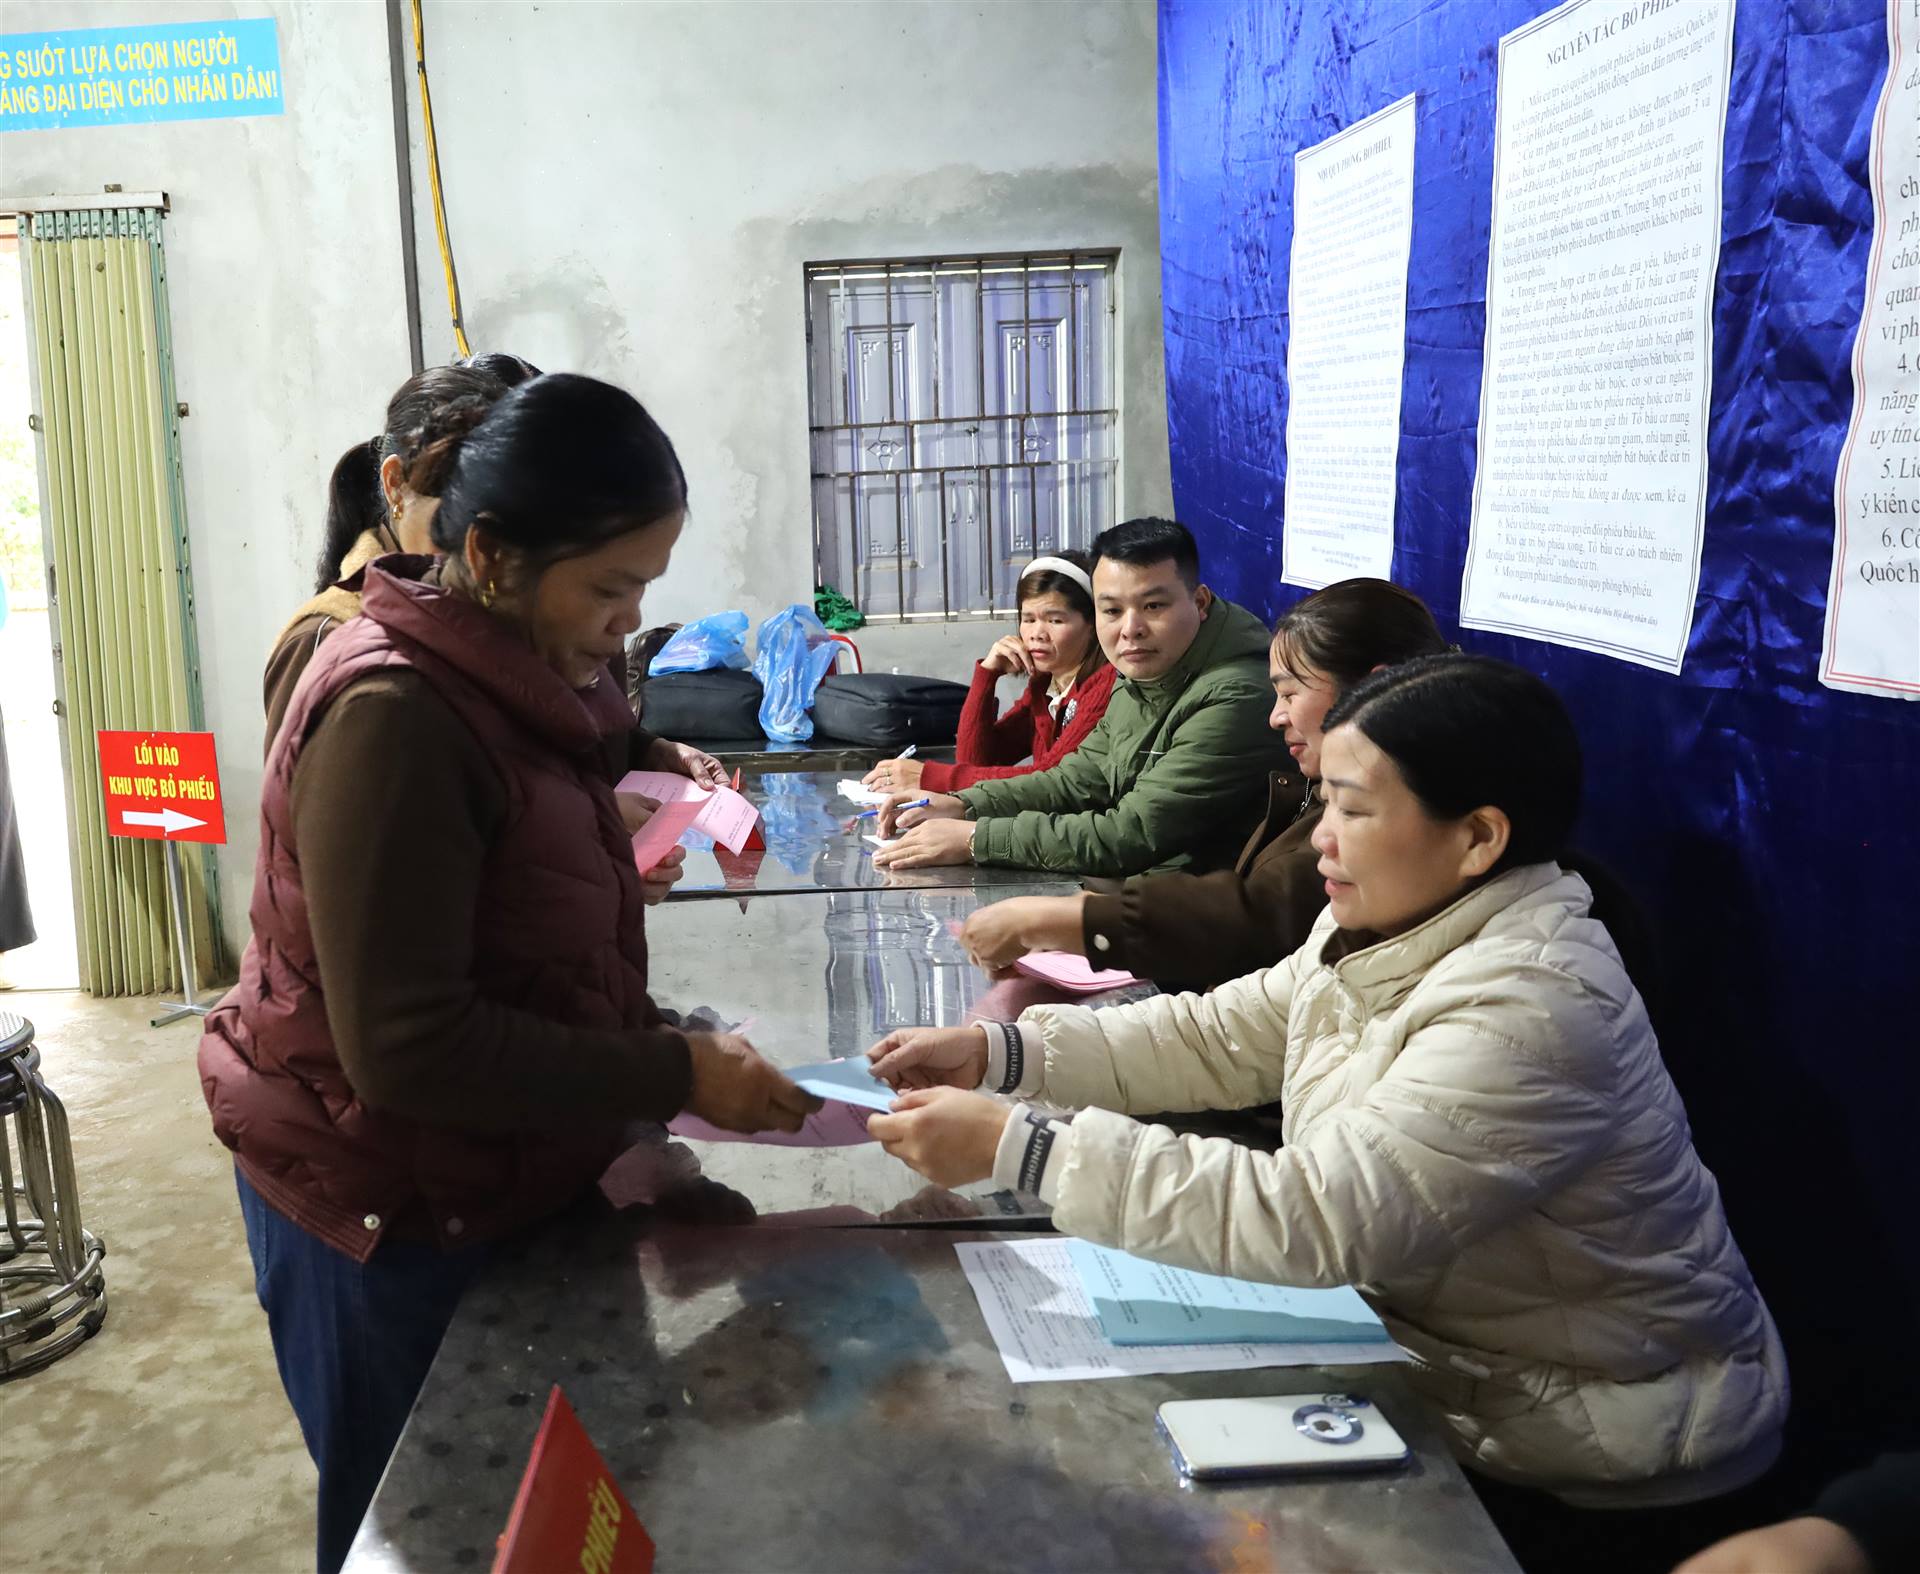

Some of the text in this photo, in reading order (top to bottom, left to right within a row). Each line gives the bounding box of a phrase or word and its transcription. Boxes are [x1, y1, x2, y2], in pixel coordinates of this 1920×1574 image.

[16, 42, 65, 79] SUỐT
[71, 44, 112, 81] LỰA
[114, 40, 169, 77] CHỌN
[172, 30, 239, 68] NGƯỜI
[43, 83, 76, 118] ĐẠI
[79, 78, 124, 116] DIỆN
[128, 76, 169, 107] CHO
[173, 67, 228, 104] NHÂN
[231, 65, 278, 100] DÂN!
[1897, 353, 1912, 374] 4.
[1880, 390, 1918, 414] năng
[1881, 458, 1895, 479] 5.
[1861, 493, 1870, 518] ý
[1874, 486, 1908, 514] kiến
[1882, 527, 1896, 548] 6.
[1860, 555, 1905, 585] Quốc
[134, 740, 180, 766] LỐI VÀO
[109, 773, 215, 800] KHU VỰC BỎ PHIẾU
